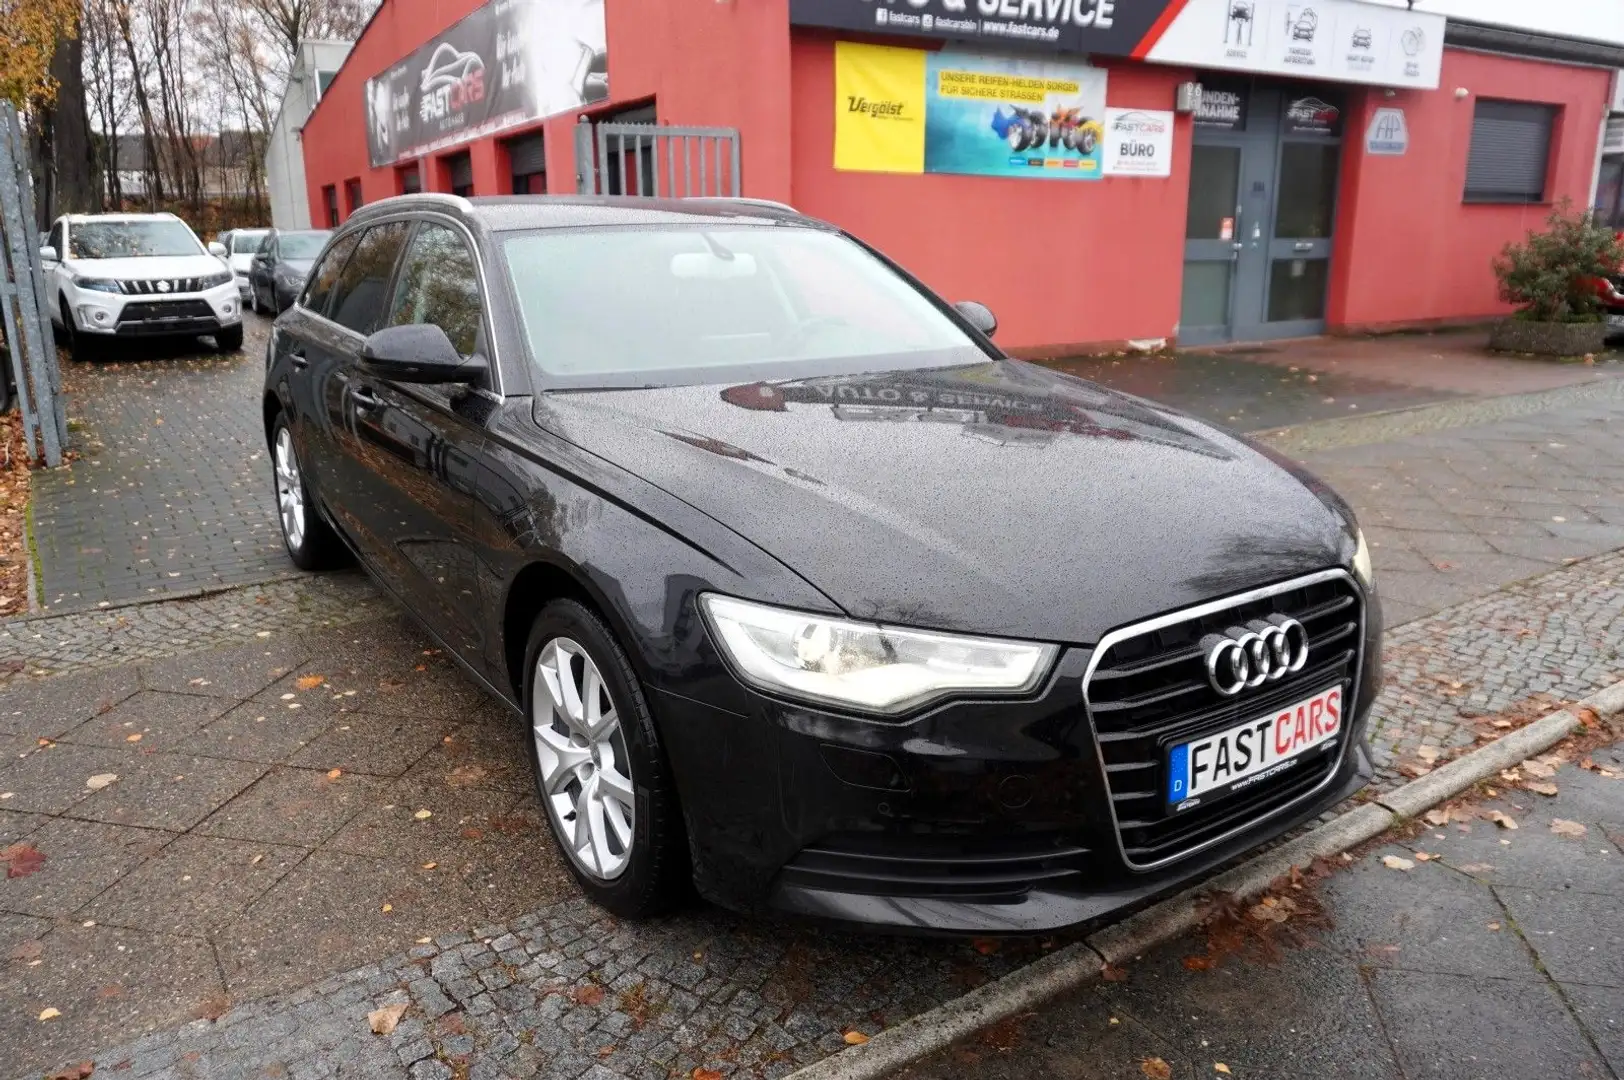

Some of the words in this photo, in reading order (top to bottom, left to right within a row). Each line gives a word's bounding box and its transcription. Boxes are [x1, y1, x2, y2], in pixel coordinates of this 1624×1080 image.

[940, 73, 977, 84] UNSERE
[961, 86, 997, 98] SICHERE
[999, 88, 1043, 101] STRASSEN
[1200, 90, 1240, 105] UNDEN-
[847, 95, 904, 118] Vergölst
[1119, 139, 1156, 157] BÜRO
[1191, 691, 1340, 790] FASTCARS
[1173, 779, 1183, 792] D
